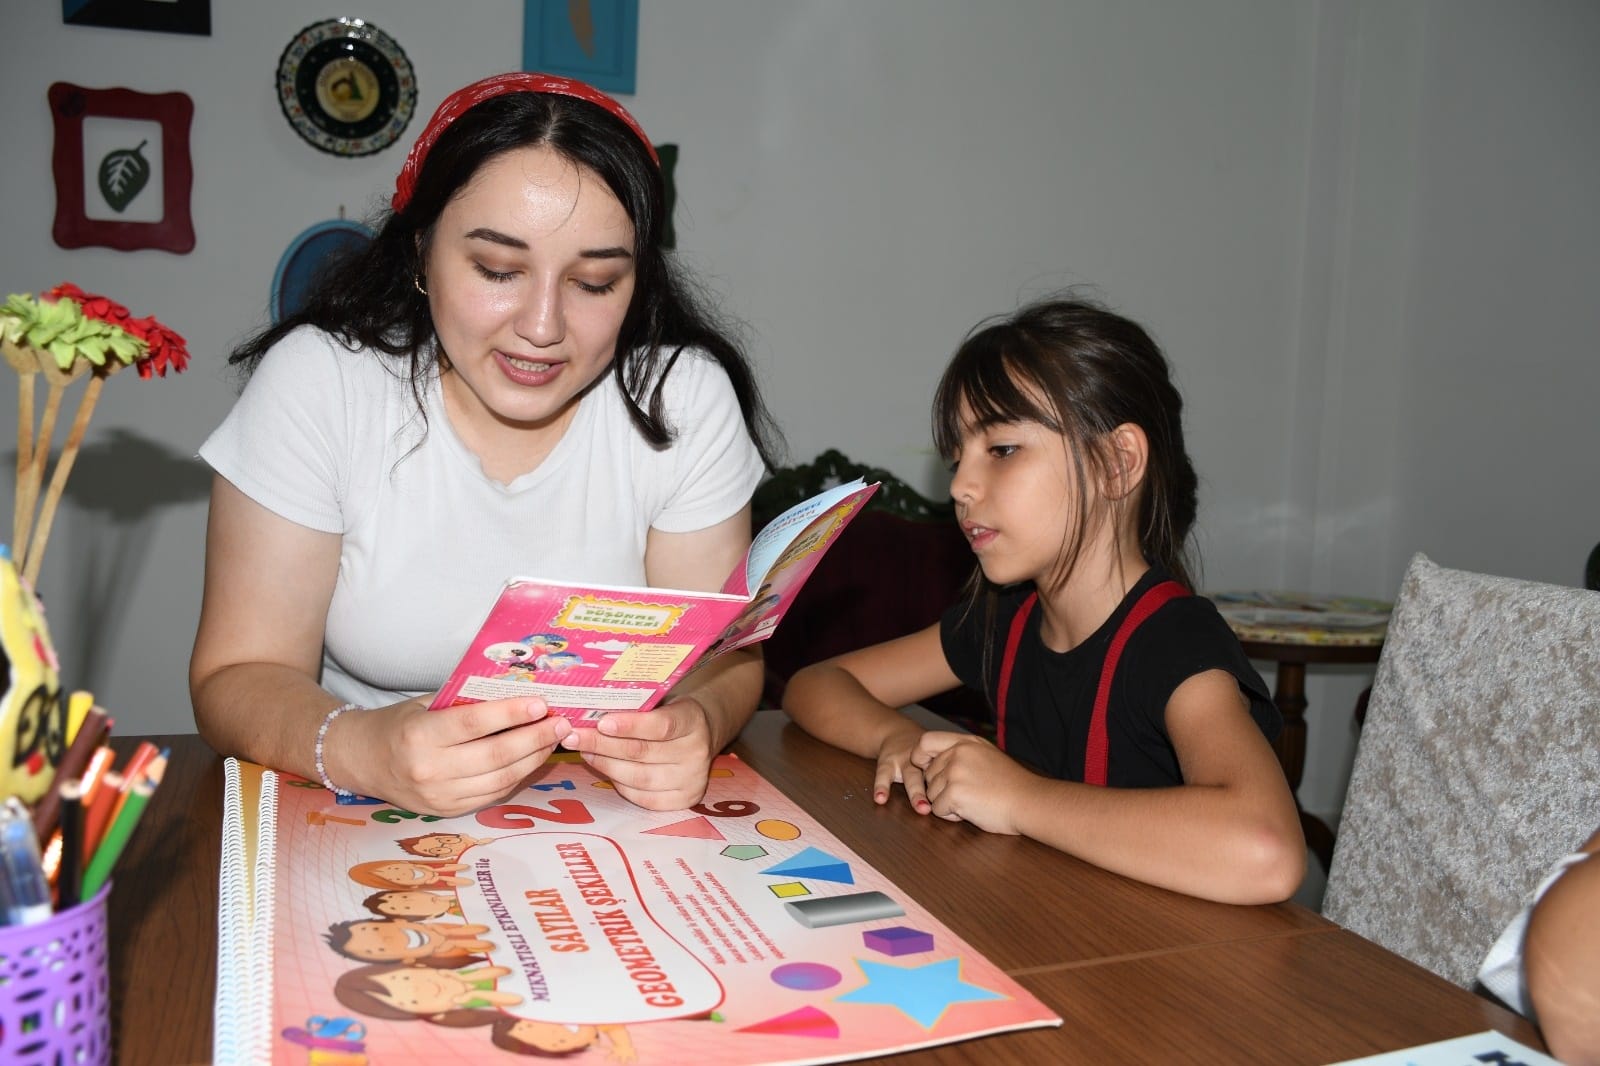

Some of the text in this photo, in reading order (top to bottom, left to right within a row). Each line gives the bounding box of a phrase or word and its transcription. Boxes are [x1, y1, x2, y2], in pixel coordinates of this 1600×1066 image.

[529, 780, 576, 791] 1
[306, 811, 366, 826] 7
[475, 799, 595, 829] 2
[475, 858, 551, 1002] MIKNATISLI ETKİNLİKLER ile
[525, 888, 590, 953] SAYILAR
[555, 842, 684, 1007] GEOMETRİK ŞEKİLLER
